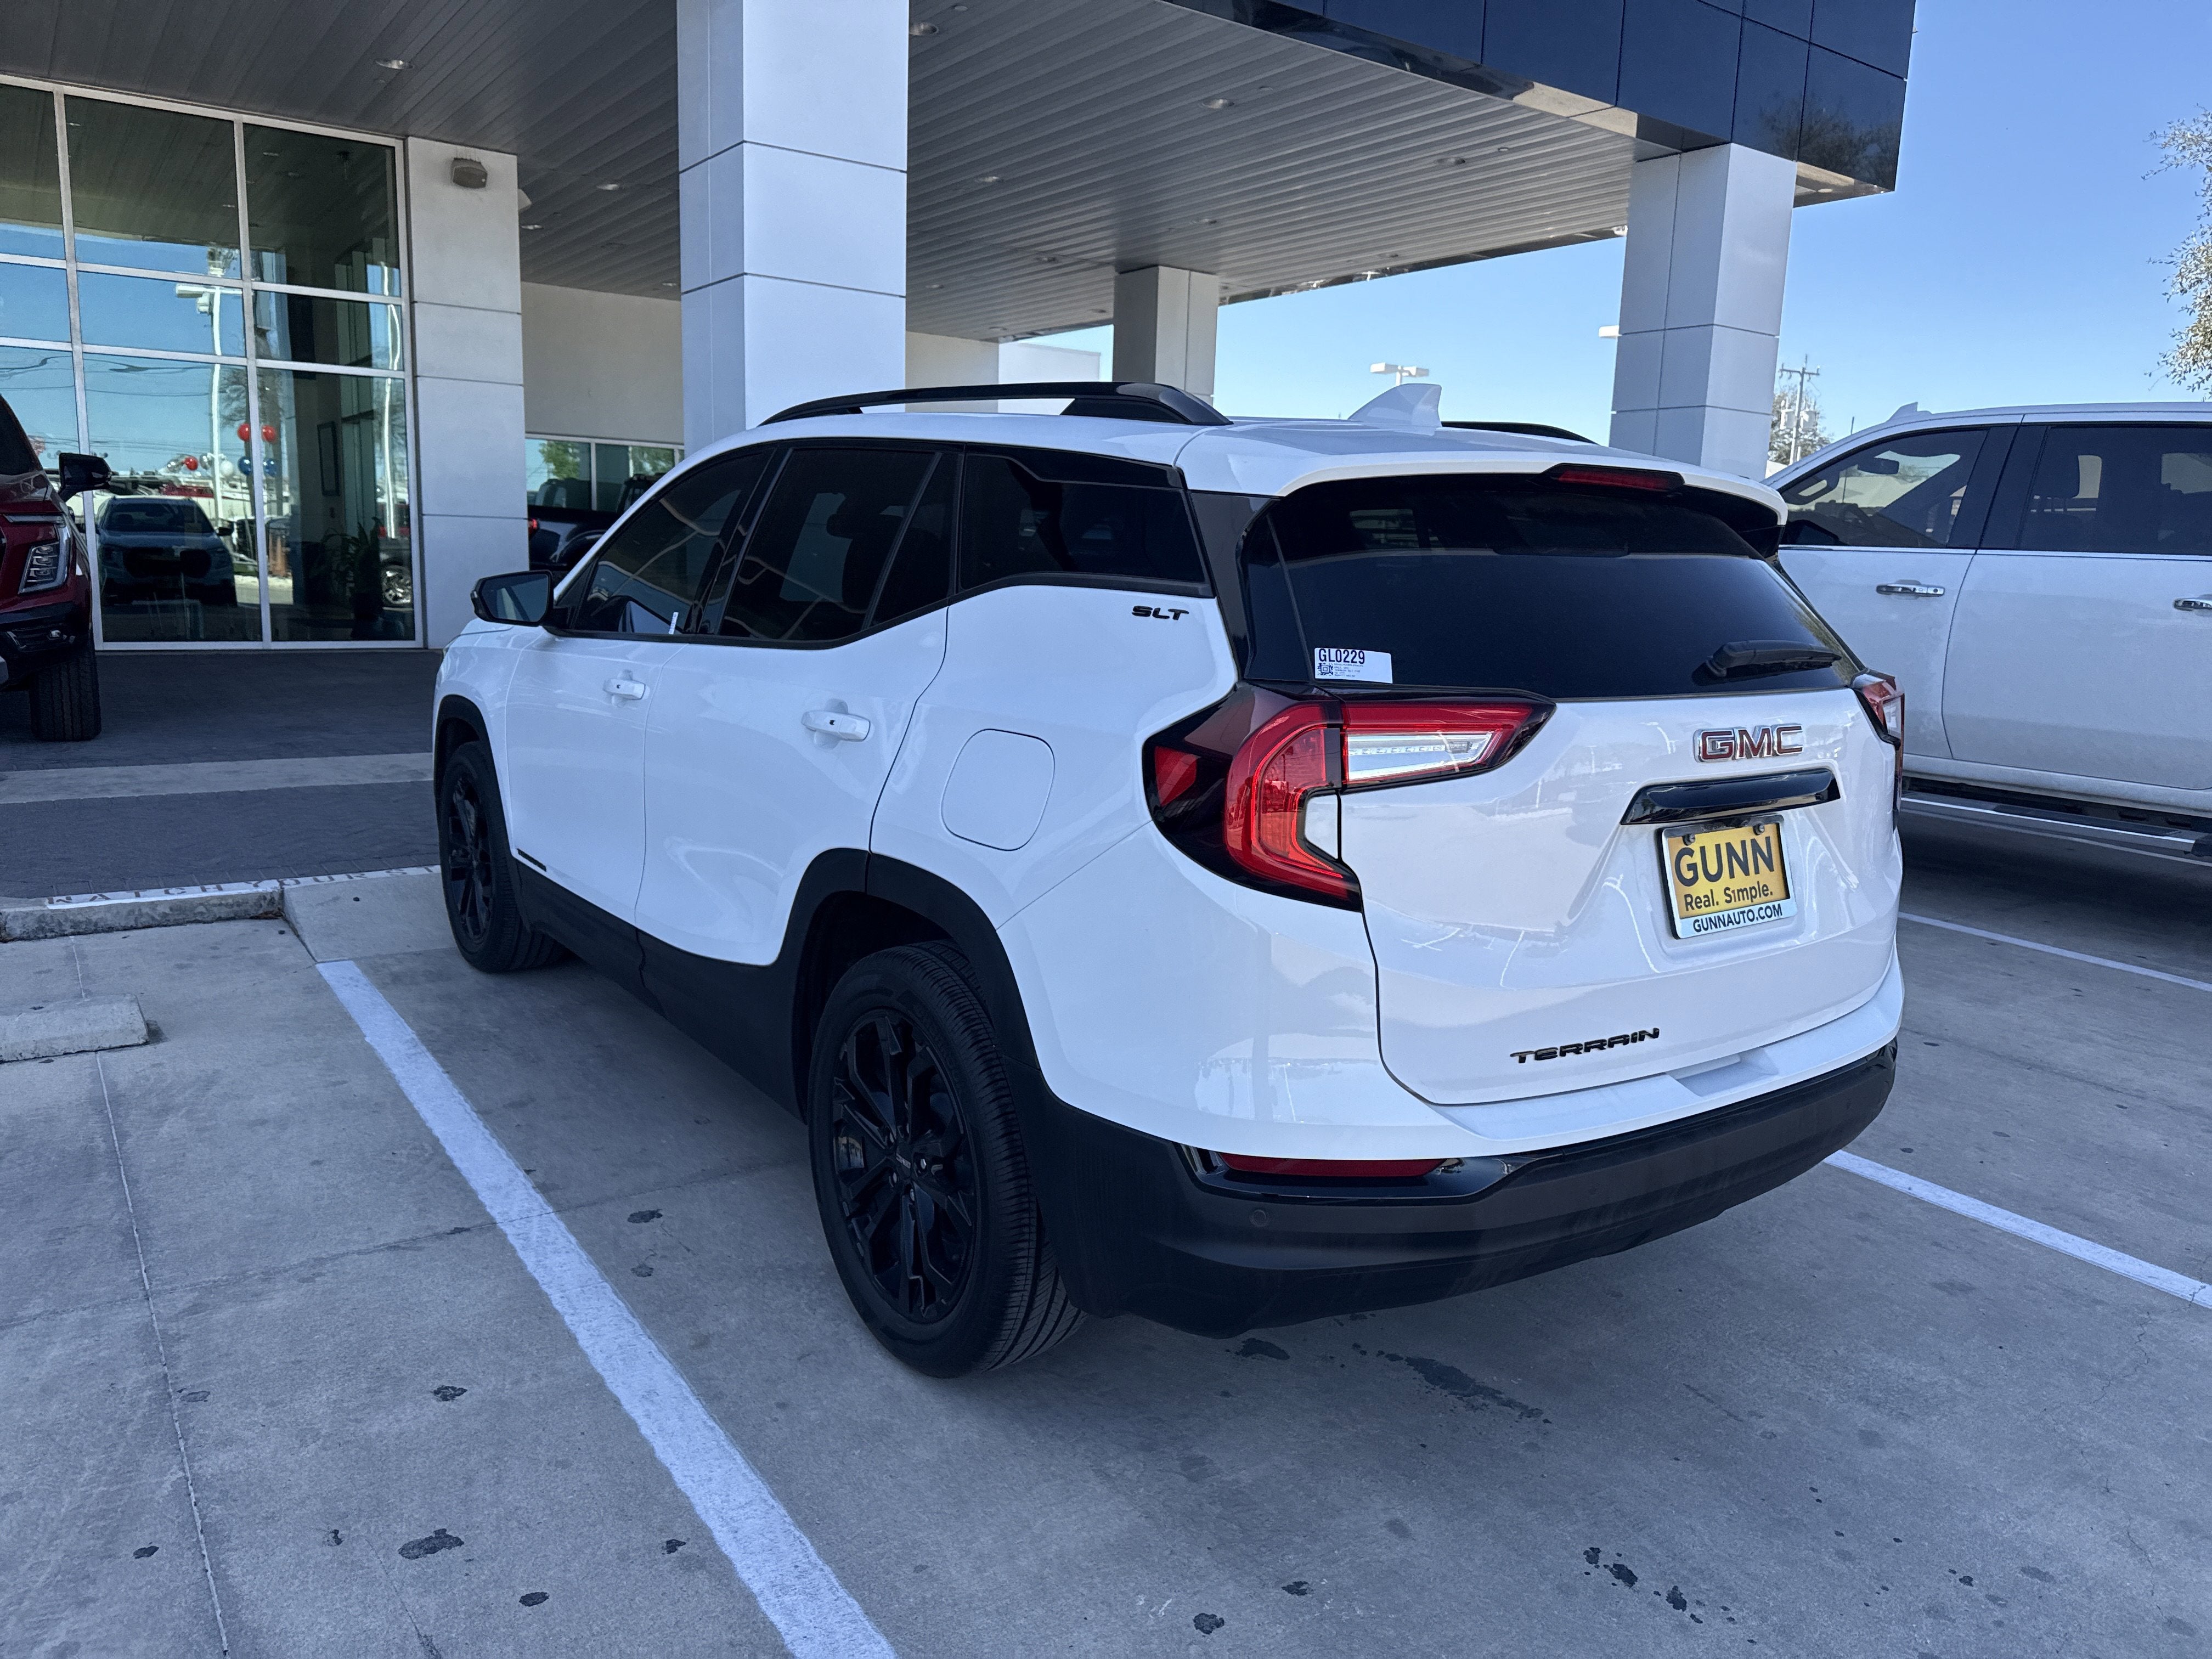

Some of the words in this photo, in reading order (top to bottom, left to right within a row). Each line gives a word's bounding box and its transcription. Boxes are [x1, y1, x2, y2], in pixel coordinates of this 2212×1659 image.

[1132, 606, 1189, 620] SLT
[1319, 648, 1365, 664] GL0229
[1694, 723, 1803, 763] GMC
[1674, 836, 1775, 887] GUNN
[47, 884, 223, 904] WATCH
[243, 873, 367, 888] YOUR
[1684, 889, 1719, 911] Real.
[1692, 903, 1783, 933] GUNNAUTO.COM
[1510, 1028, 1660, 1064] TERRAIN
